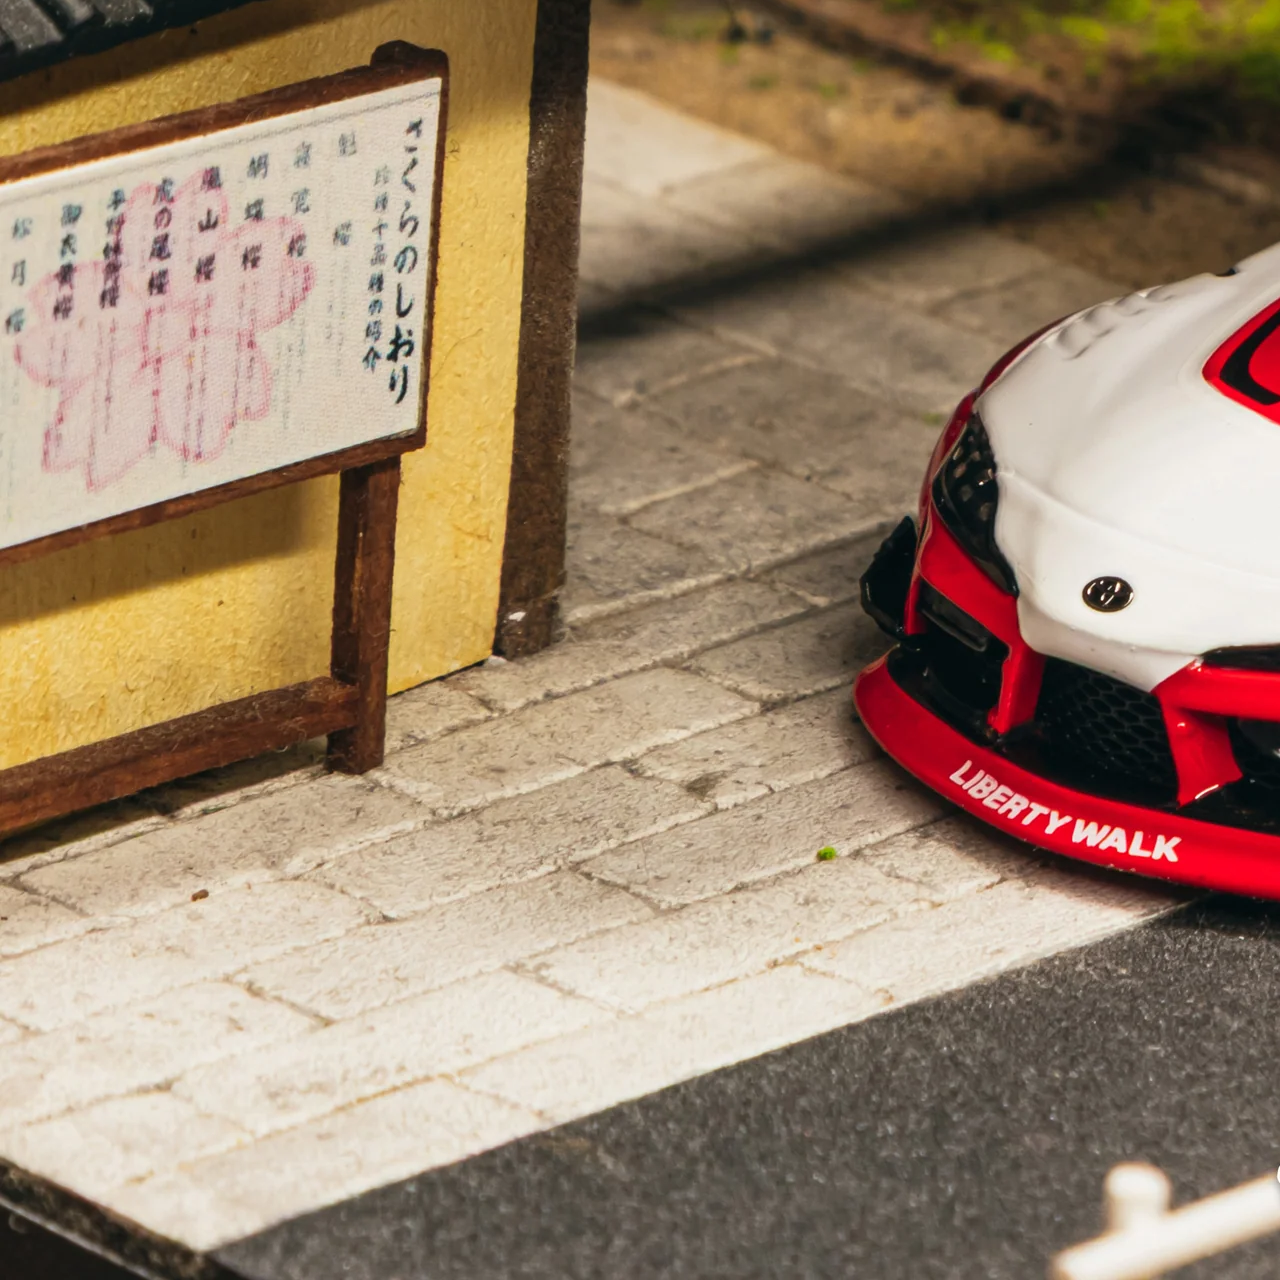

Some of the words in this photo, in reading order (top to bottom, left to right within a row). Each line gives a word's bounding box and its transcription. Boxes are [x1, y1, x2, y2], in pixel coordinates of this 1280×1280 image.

[387, 117, 423, 405] さくらのしおり
[949, 760, 1072, 834] LIBERTY
[1072, 819, 1182, 862] WALK
